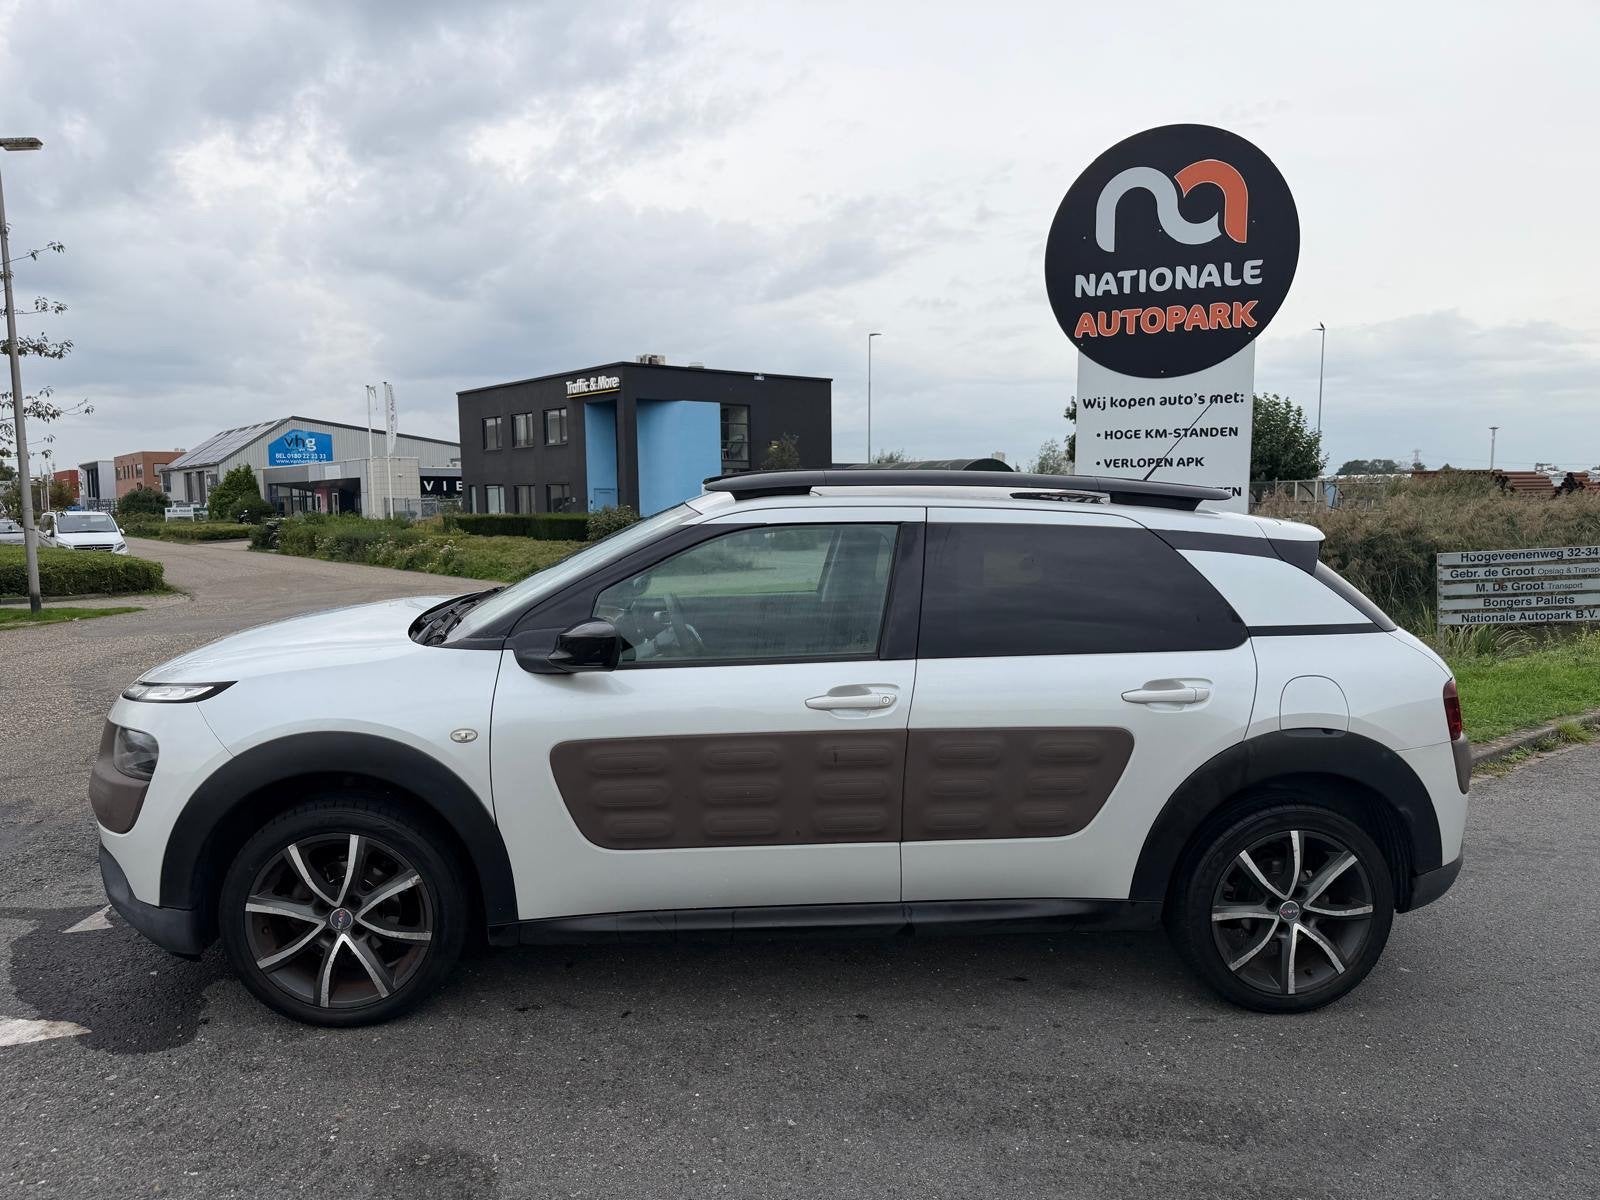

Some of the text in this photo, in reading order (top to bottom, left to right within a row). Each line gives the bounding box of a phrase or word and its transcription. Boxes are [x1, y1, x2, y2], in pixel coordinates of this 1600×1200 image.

[1074, 260, 1263, 297] NATIONALE
[1074, 300, 1259, 338] AUTOPARK
[566, 378, 590, 394] Traffic
[590, 377, 596, 391] &
[1082, 392, 1244, 411] Wij kopen auto's met:
[1104, 426, 1238, 440] HOGE KM-STANDEN
[284, 434, 316, 451] vhg
[1104, 457, 1204, 468] VERLOPEN APK
[1460, 548, 1598, 564] Hoogeveenenweg 32-34
[1450, 569, 1480, 578] Gebr.
[1484, 568, 1498, 577] de
[1502, 566, 1534, 576] Groot
[1574, 566, 1600, 574] Transp
[1476, 582, 1583, 592] M. De Groot Transport
[1484, 595, 1575, 608] Bongers Pallets
[1461, 610, 1598, 623] Nationale Autopark B.V.
